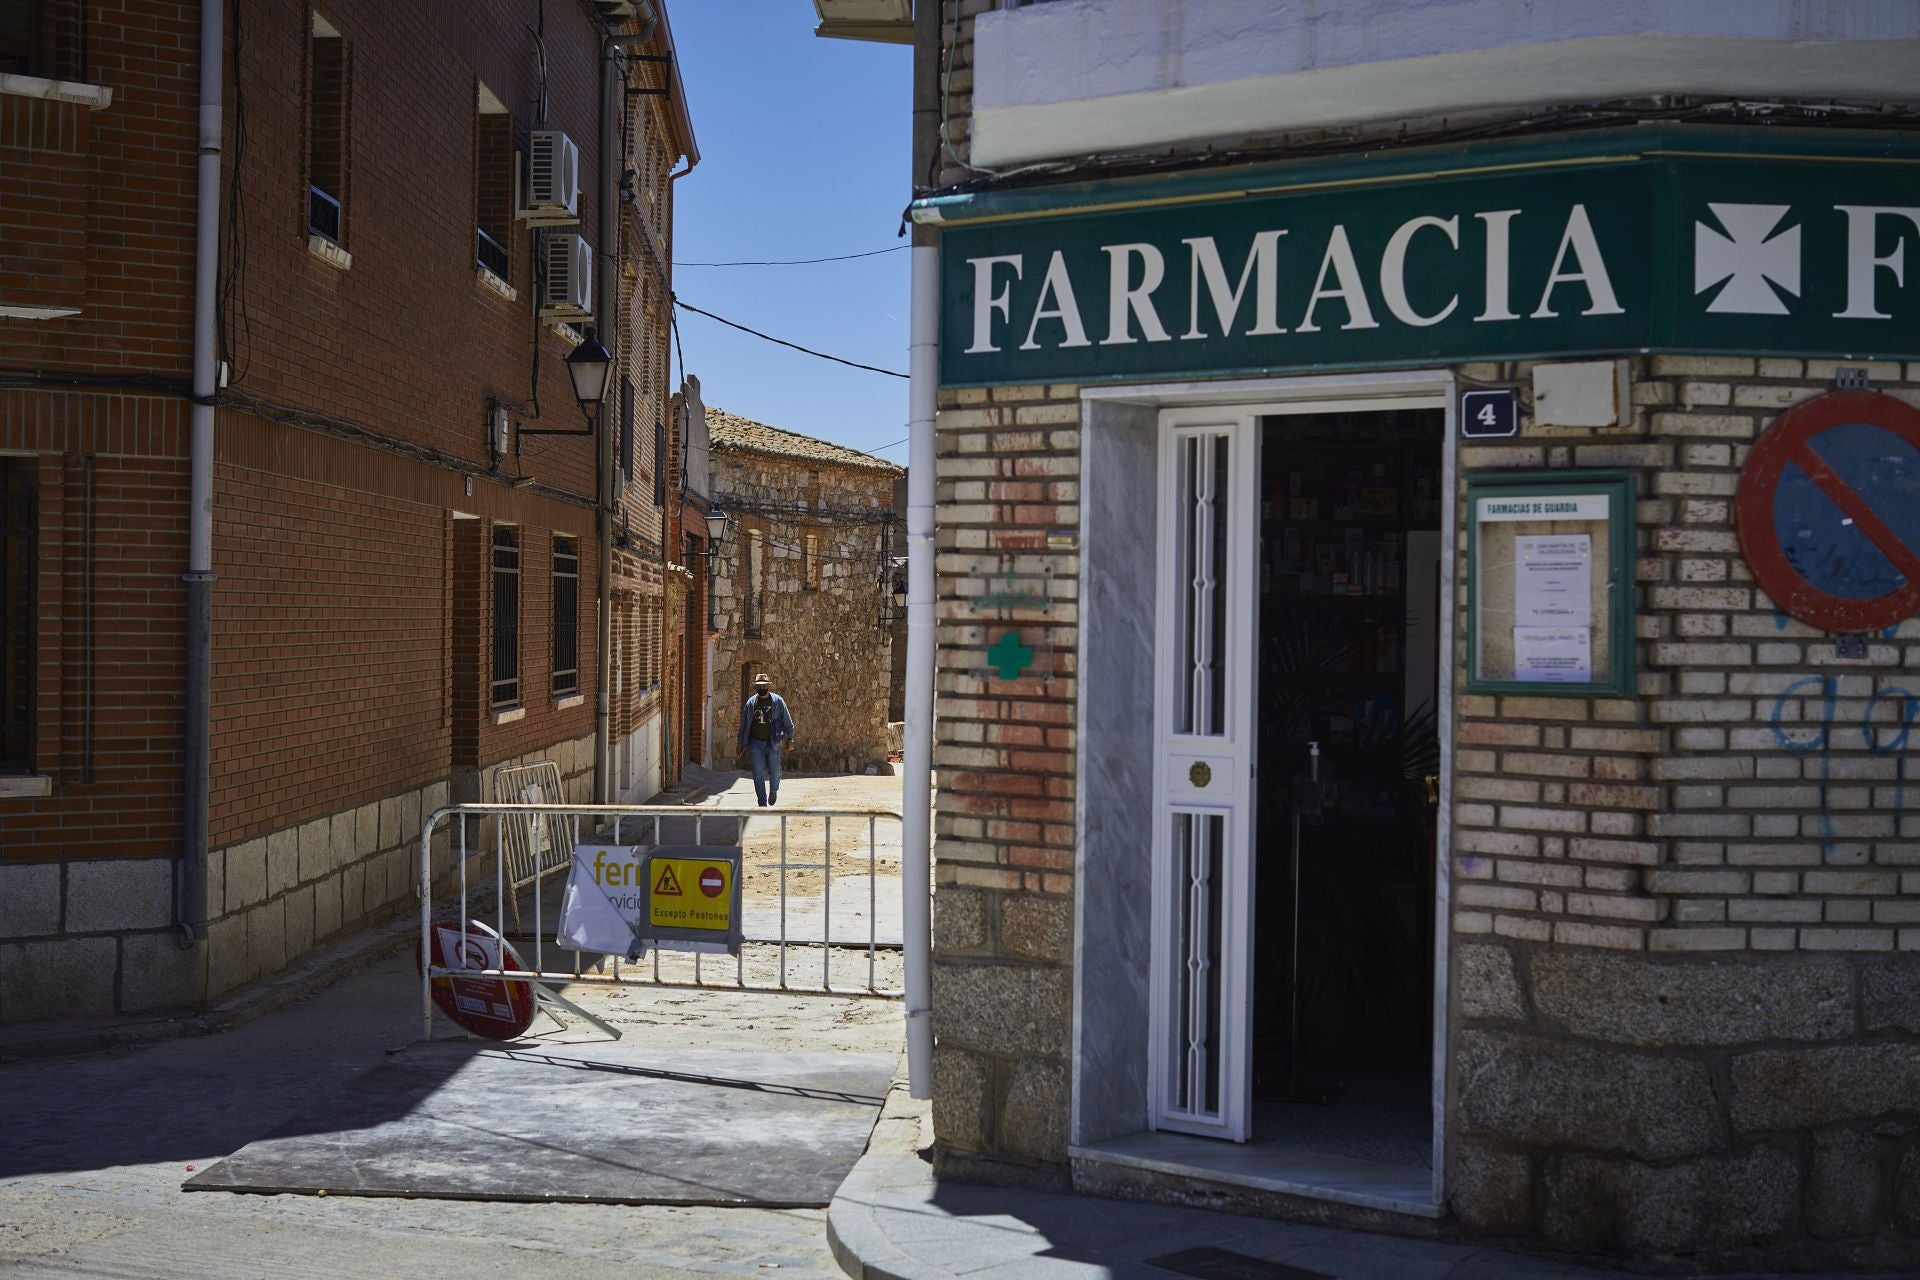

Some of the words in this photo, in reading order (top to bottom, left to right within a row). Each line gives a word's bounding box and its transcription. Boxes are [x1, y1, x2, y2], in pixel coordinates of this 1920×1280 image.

[964, 203, 1625, 355] FARMACIA
[1477, 403, 1496, 426] 4
[1487, 503, 1530, 515] FARMACIAS
[1532, 503, 1542, 514] DE
[1544, 502, 1578, 513] GUARDIA
[654, 907, 687, 920] Excepto
[690, 909, 729, 921] Peatones
